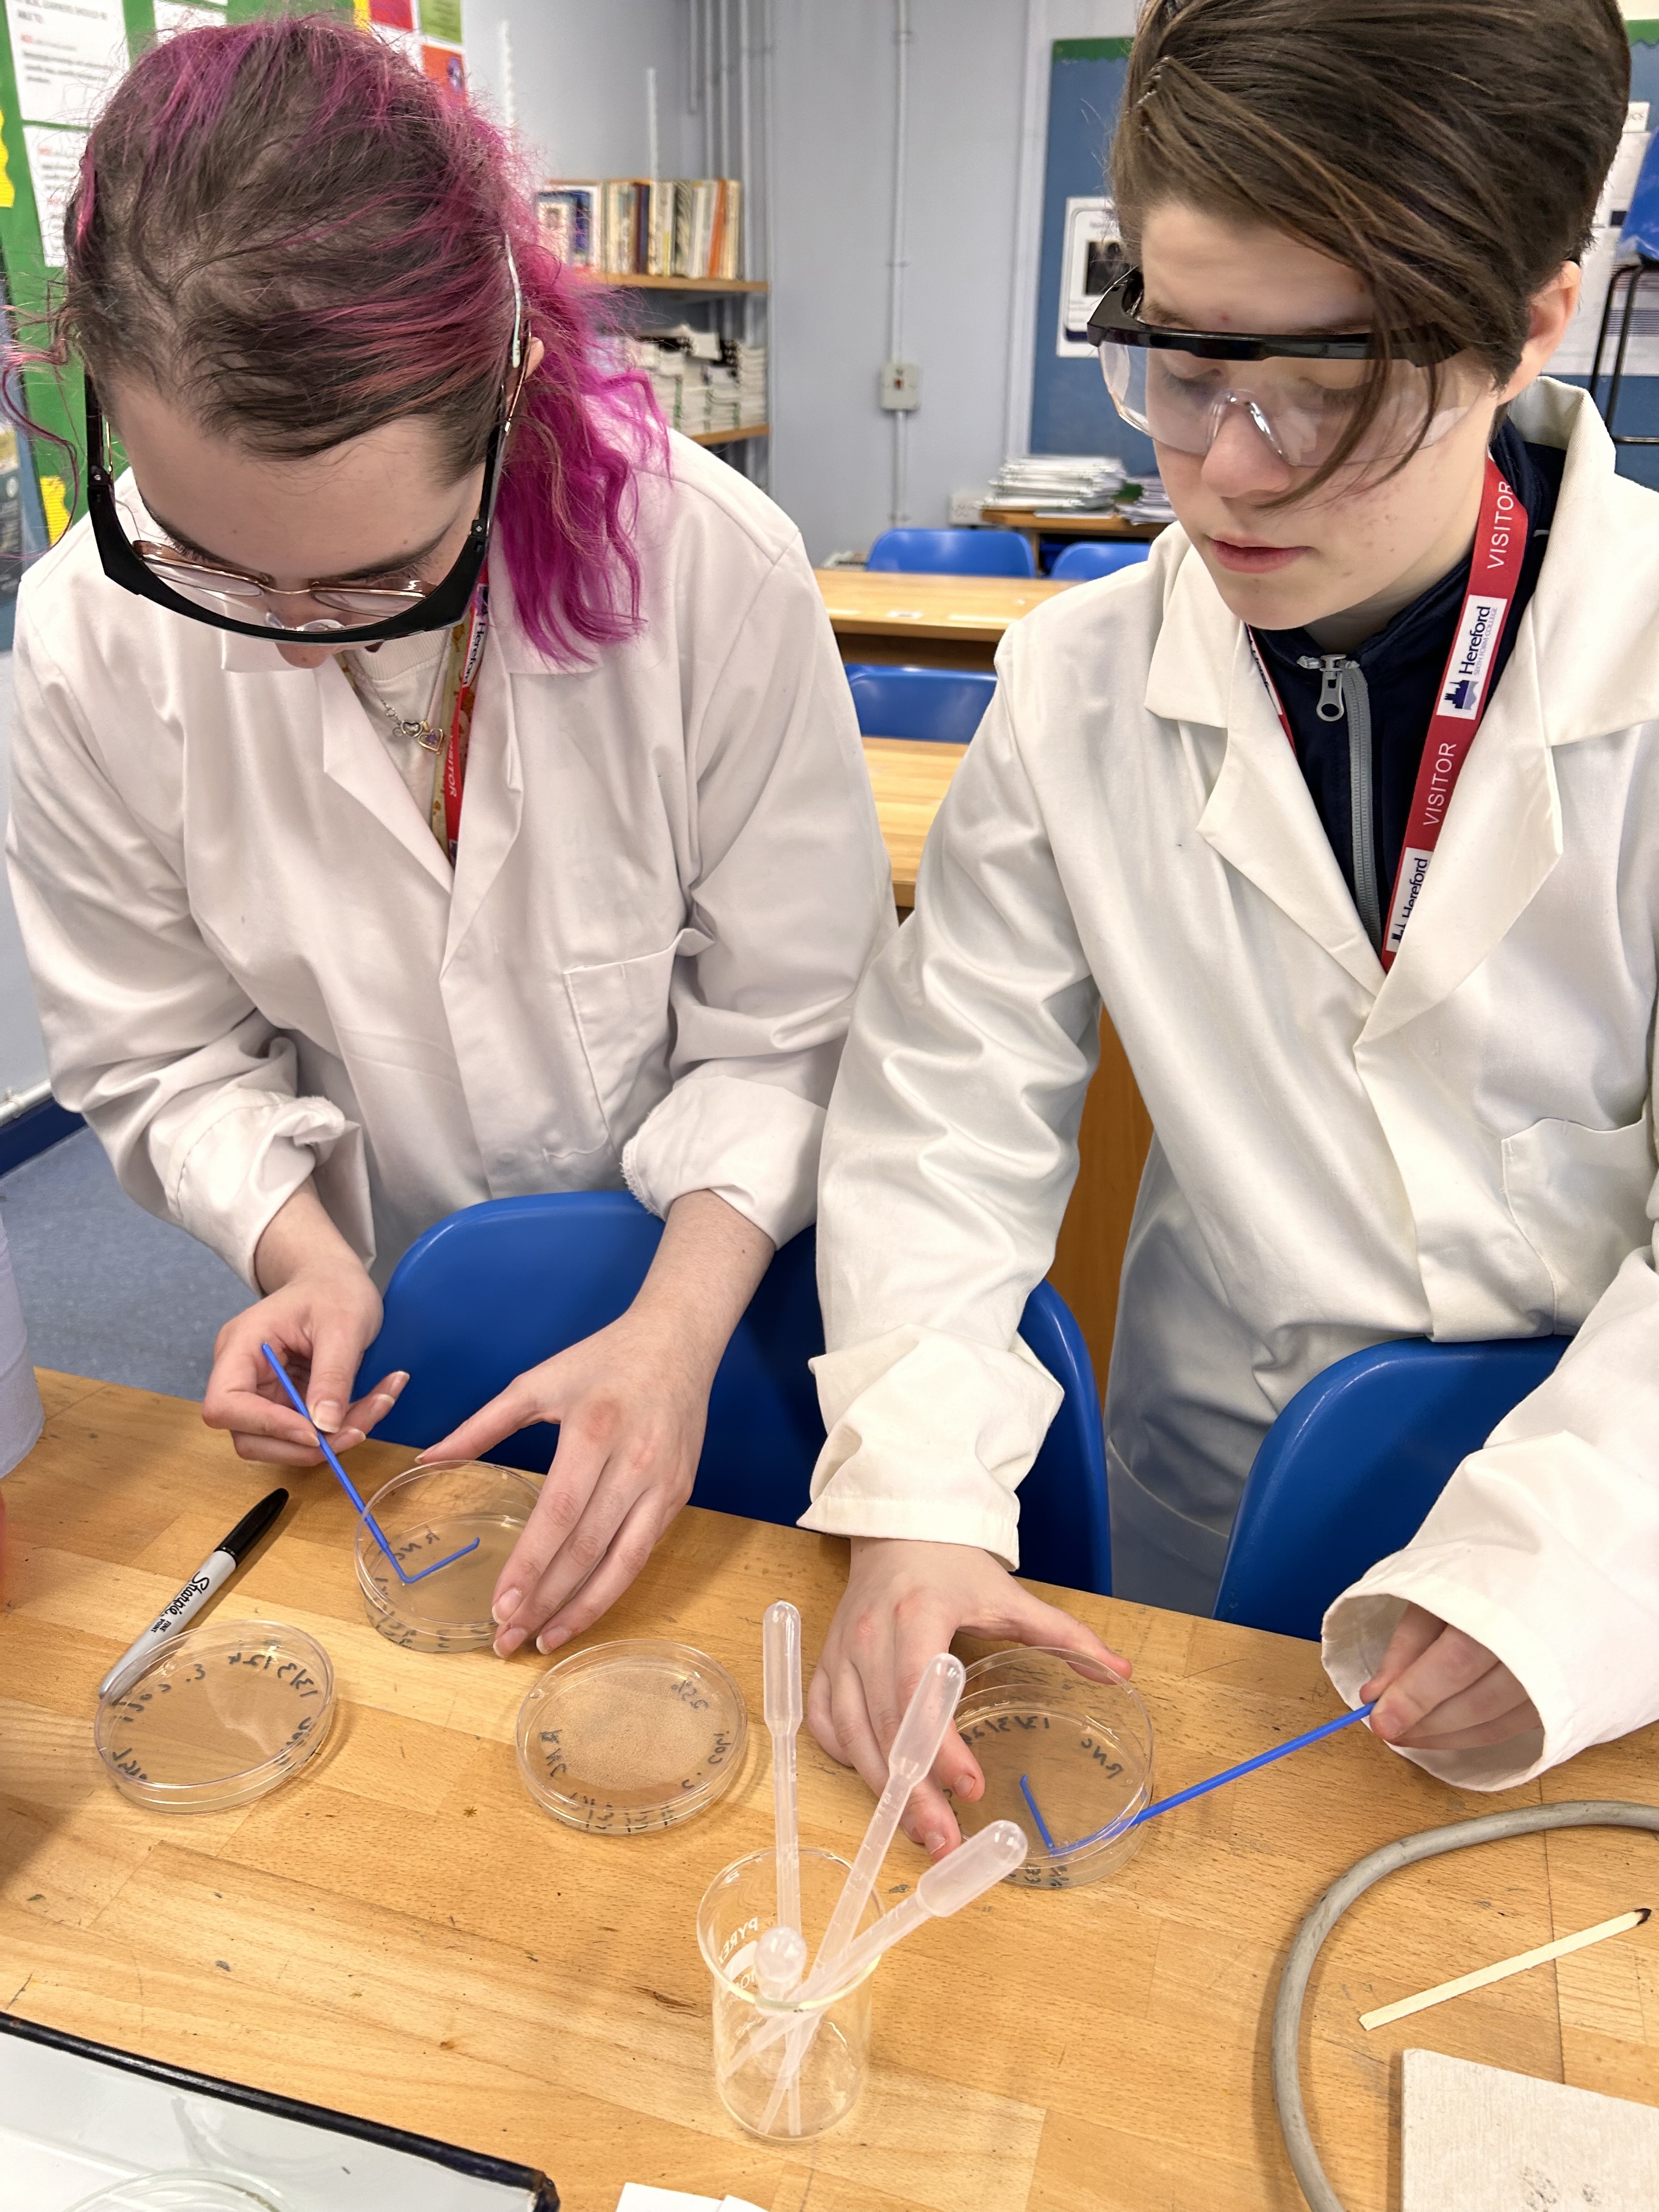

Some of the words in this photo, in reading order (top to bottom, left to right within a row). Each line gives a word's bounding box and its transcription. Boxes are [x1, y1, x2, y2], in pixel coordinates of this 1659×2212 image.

[1487, 481, 1514, 569] VISITOR
[463, 622, 486, 685] Hereford
[1458, 606, 1491, 675] Hereford
[1423, 742, 1457, 826] VISITOR
[1402, 857, 1428, 918] Hereford
[164, 1571, 210, 1615] Sharpie
[150, 1618, 166, 1633] POINT
[159, 1620, 172, 1633] FINE
